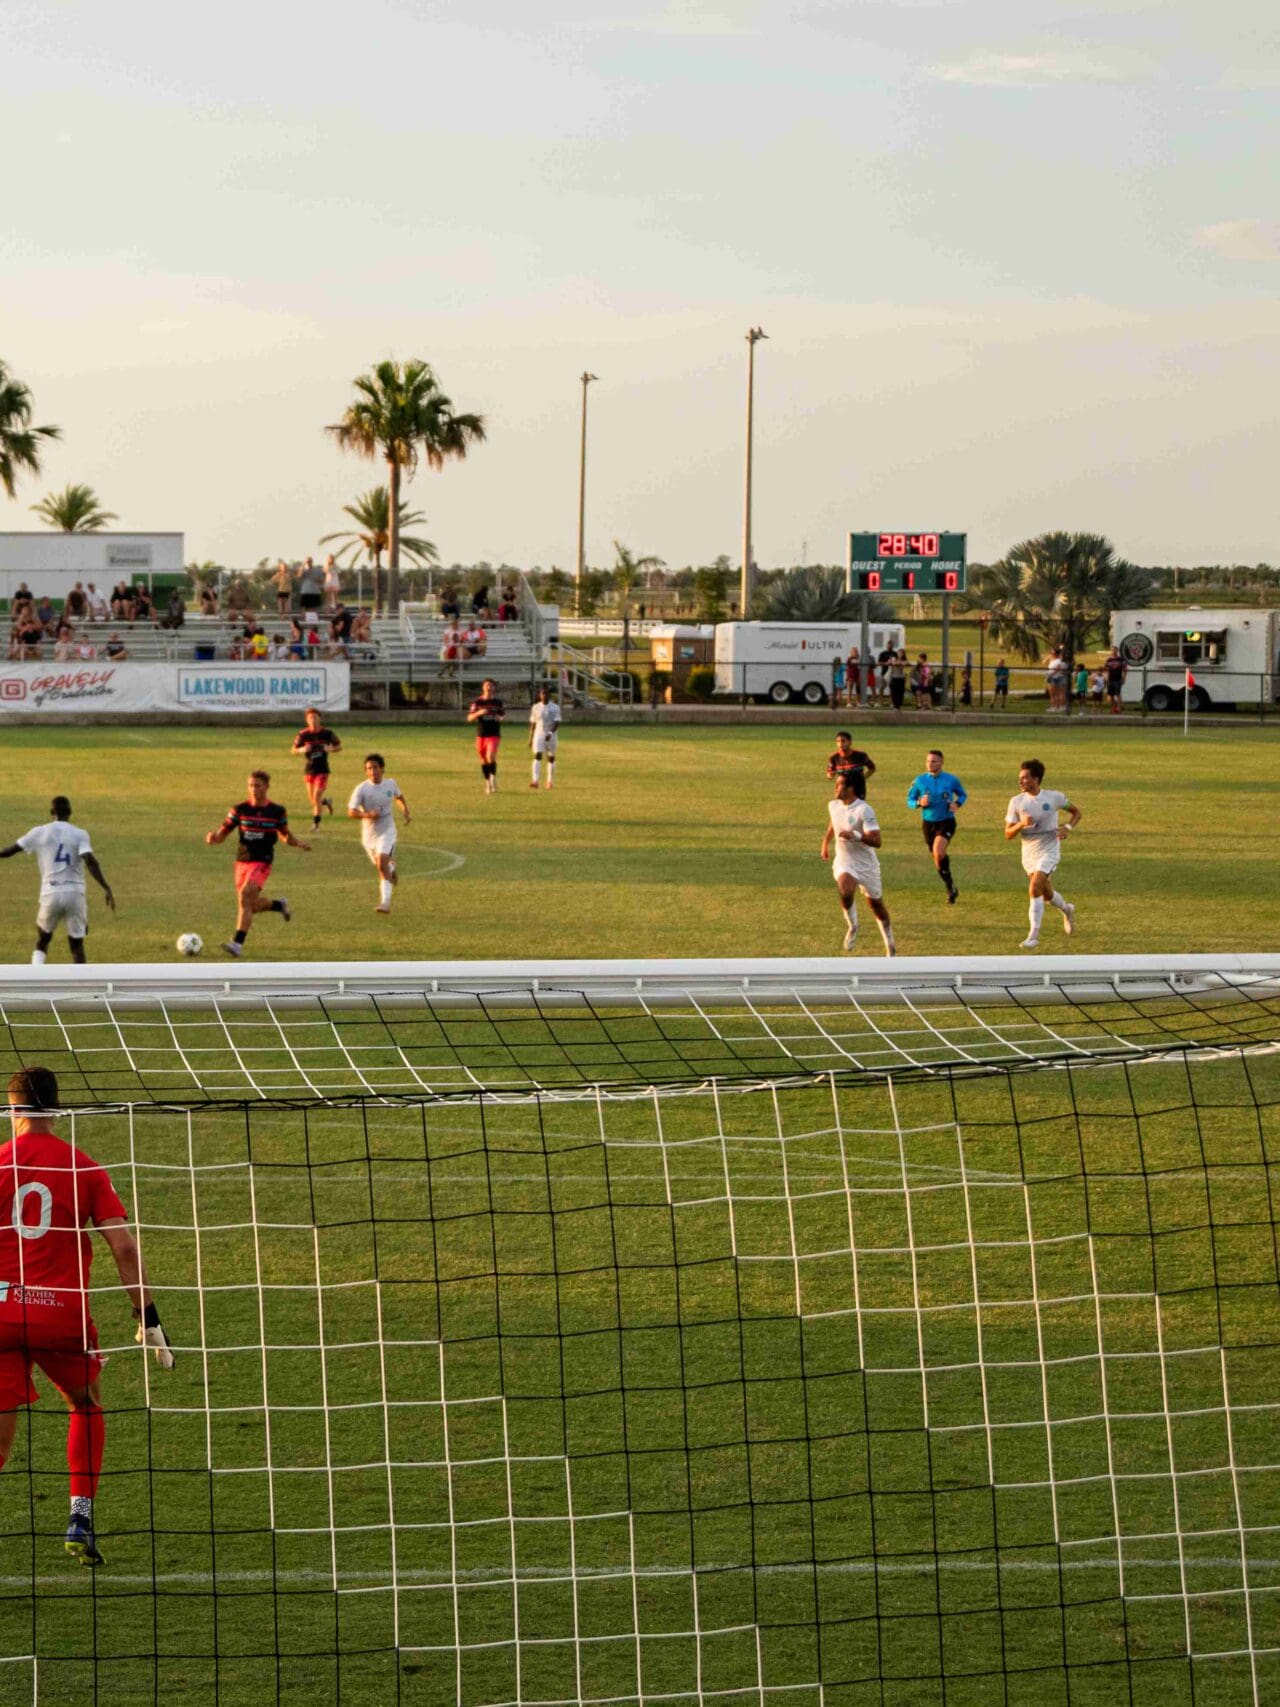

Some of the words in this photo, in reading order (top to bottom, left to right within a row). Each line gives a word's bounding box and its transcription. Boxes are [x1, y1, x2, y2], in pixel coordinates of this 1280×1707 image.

[879, 534, 937, 556] 28:40
[852, 561, 886, 570] GUEST
[894, 562, 922, 570] PERIOD
[931, 561, 961, 570] HOME
[868, 572, 880, 590] 0
[908, 572, 915, 590] 1
[945, 572, 958, 590] 0
[808, 641, 842, 650] ULTRA
[184, 677, 265, 695] LAKEWOOD
[270, 677, 320, 695] RANCH
[54, 843, 70, 865] 4
[12, 1181, 52, 1239] 0
